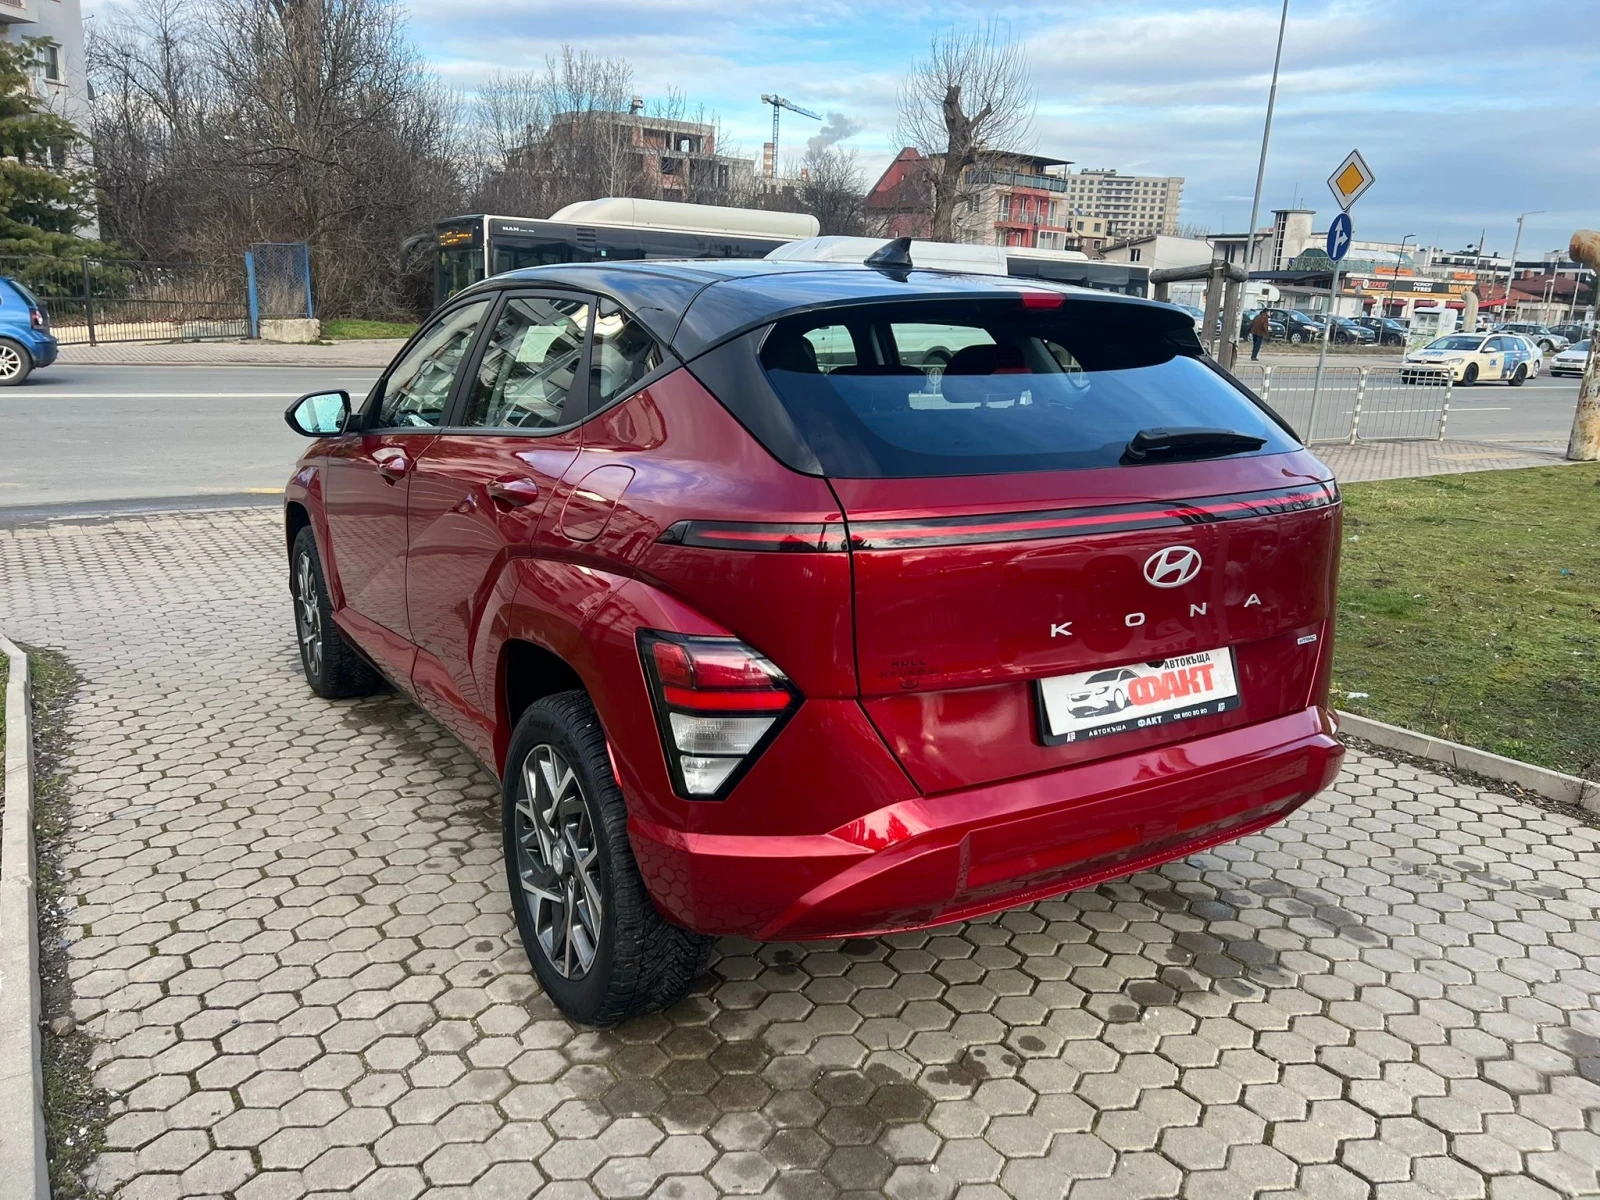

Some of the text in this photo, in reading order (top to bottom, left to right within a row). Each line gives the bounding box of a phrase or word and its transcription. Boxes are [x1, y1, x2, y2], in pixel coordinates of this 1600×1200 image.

[1050, 593, 1262, 637] KONA
[1164, 652, 1211, 670] АВТОКЪЩА
[1128, 663, 1214, 706] ФАКТ
[1137, 715, 1162, 727] ФАКТ
